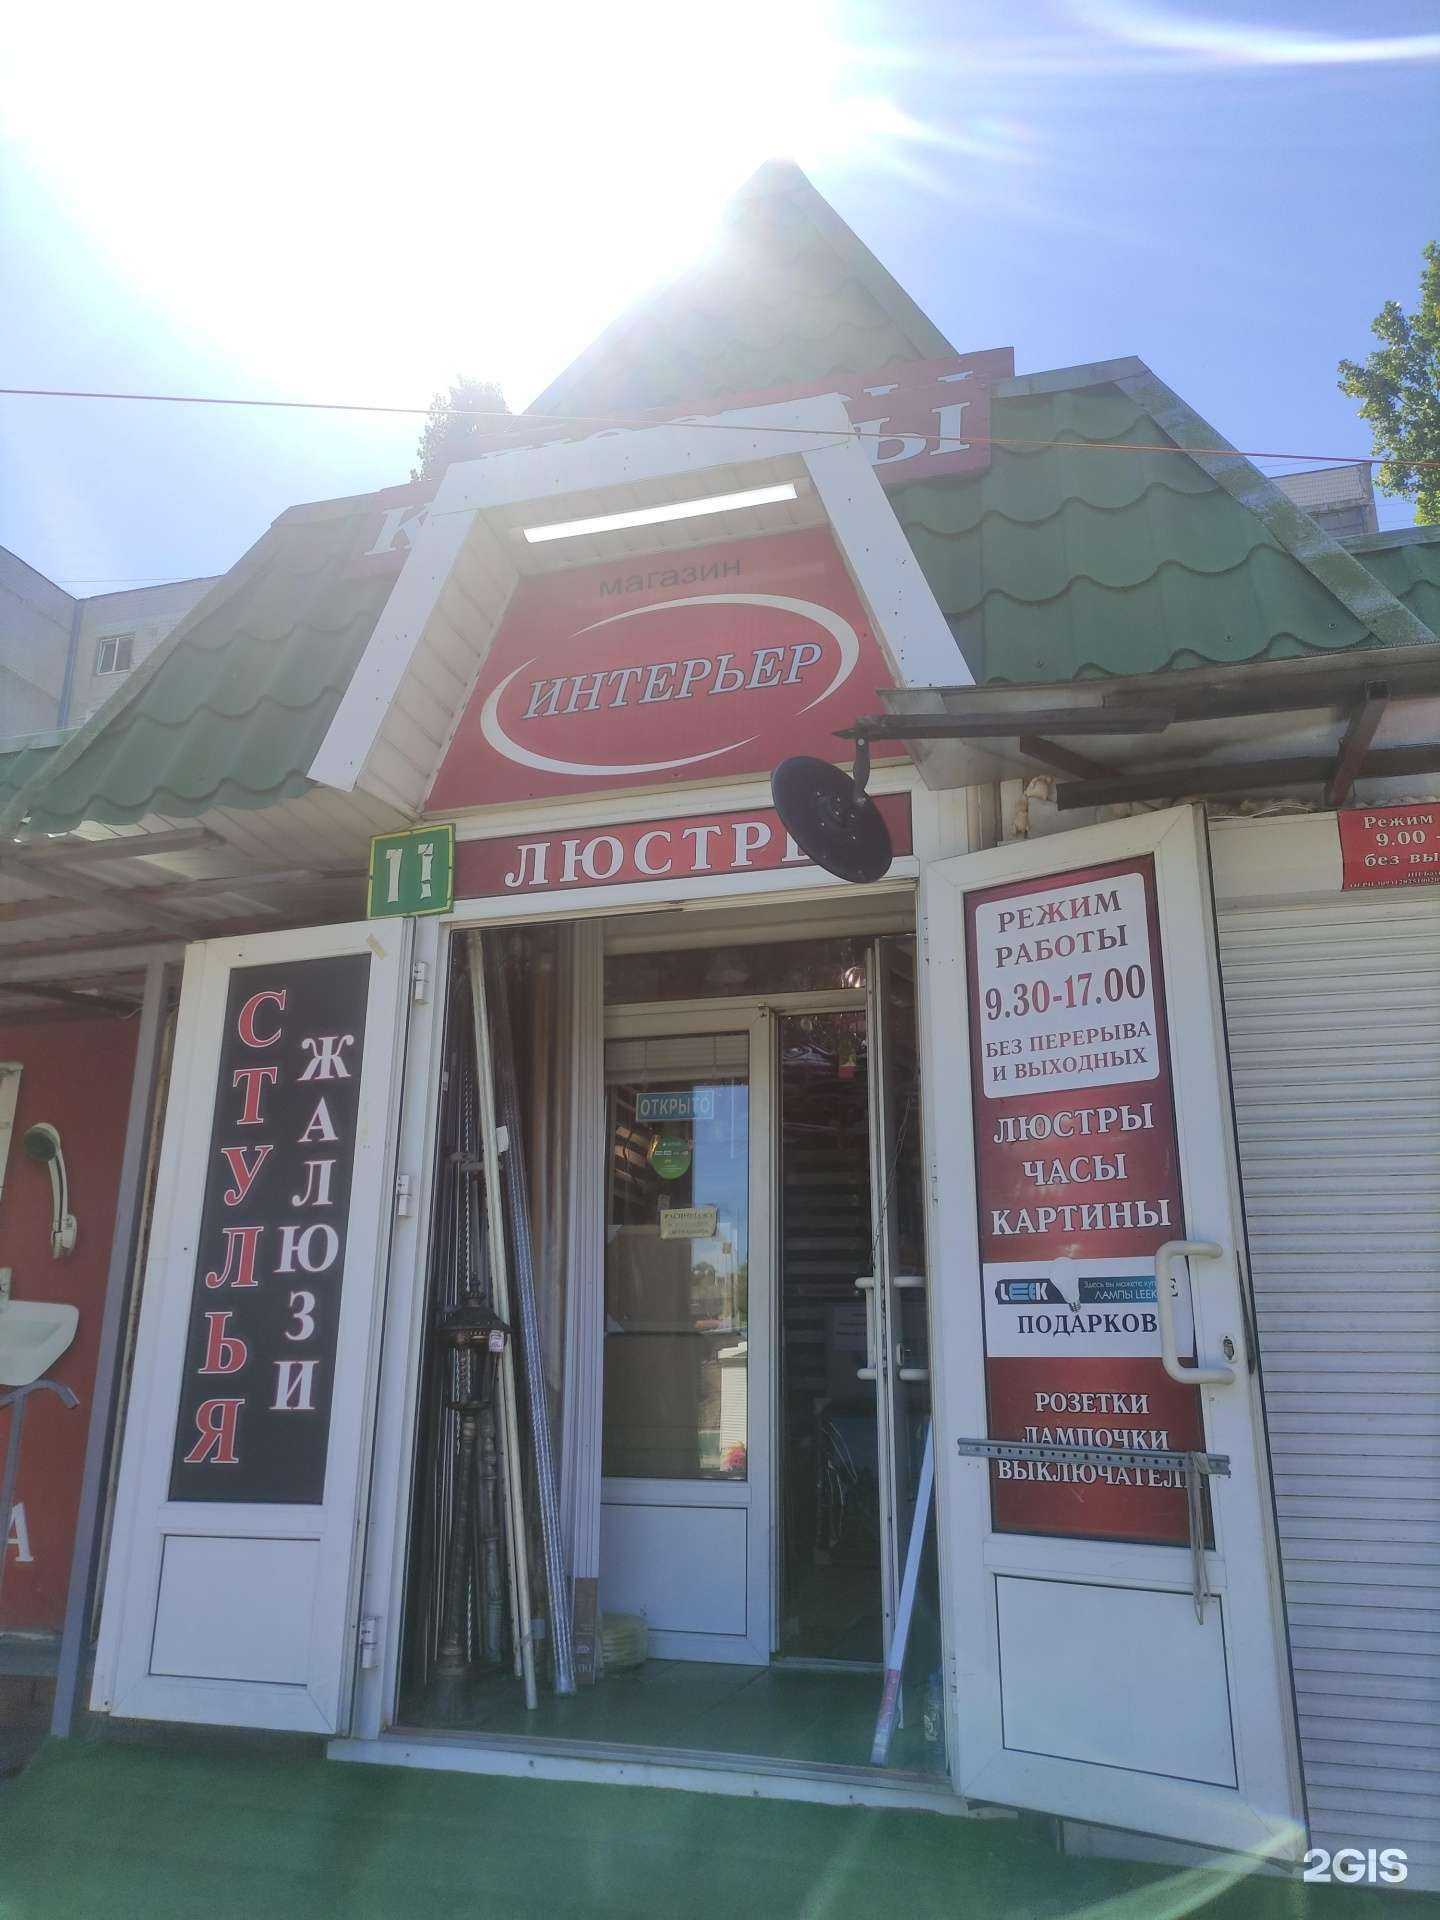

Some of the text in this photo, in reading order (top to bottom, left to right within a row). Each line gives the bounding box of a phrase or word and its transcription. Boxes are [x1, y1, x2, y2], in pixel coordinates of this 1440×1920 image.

[600, 560, 741, 597] магазин
[521, 642, 822, 719] ИНТЕРЬЕР
[1364, 815, 1433, 829] Режим
[1376, 830, 1426, 847] 9.00
[504, 821, 809, 888] ЛЮСТР
[1364, 853, 1401, 867] без
[997, 890, 1122, 933] РЕЖИМ
[995, 924, 1128, 968] РАБОТЫ
[985, 964, 1146, 1021] 9.30-17.00
[985, 1021, 1152, 1058] БЕЗ ПЕРЕРЫВА
[992, 1047, 1149, 1082] И ВЫХОДНЫХ
[640, 1097, 711, 1117] ОТКРЫТО
[993, 1103, 1155, 1143] ЛЮСТРЫ
[1022, 1153, 1128, 1186] ЧАСЫ
[184, 989, 288, 1463] СТУЛЬЯ
[269, 1034, 354, 1411] ЖАЛЮЗИ
[991, 1200, 1172, 1235] КАРТИНЫ
[1094, 1290, 1133, 1300] ЛАМПЫ
[1017, 1313, 1158, 1336] ПОДАРКОВ
[1035, 1392, 1150, 1414] РОЗЕТКИ
[1022, 1427, 1169, 1450] ЛАМПОЧКИ
[997, 1459, 1203, 1488] ВЫКЛЮЧАТЕЛ
